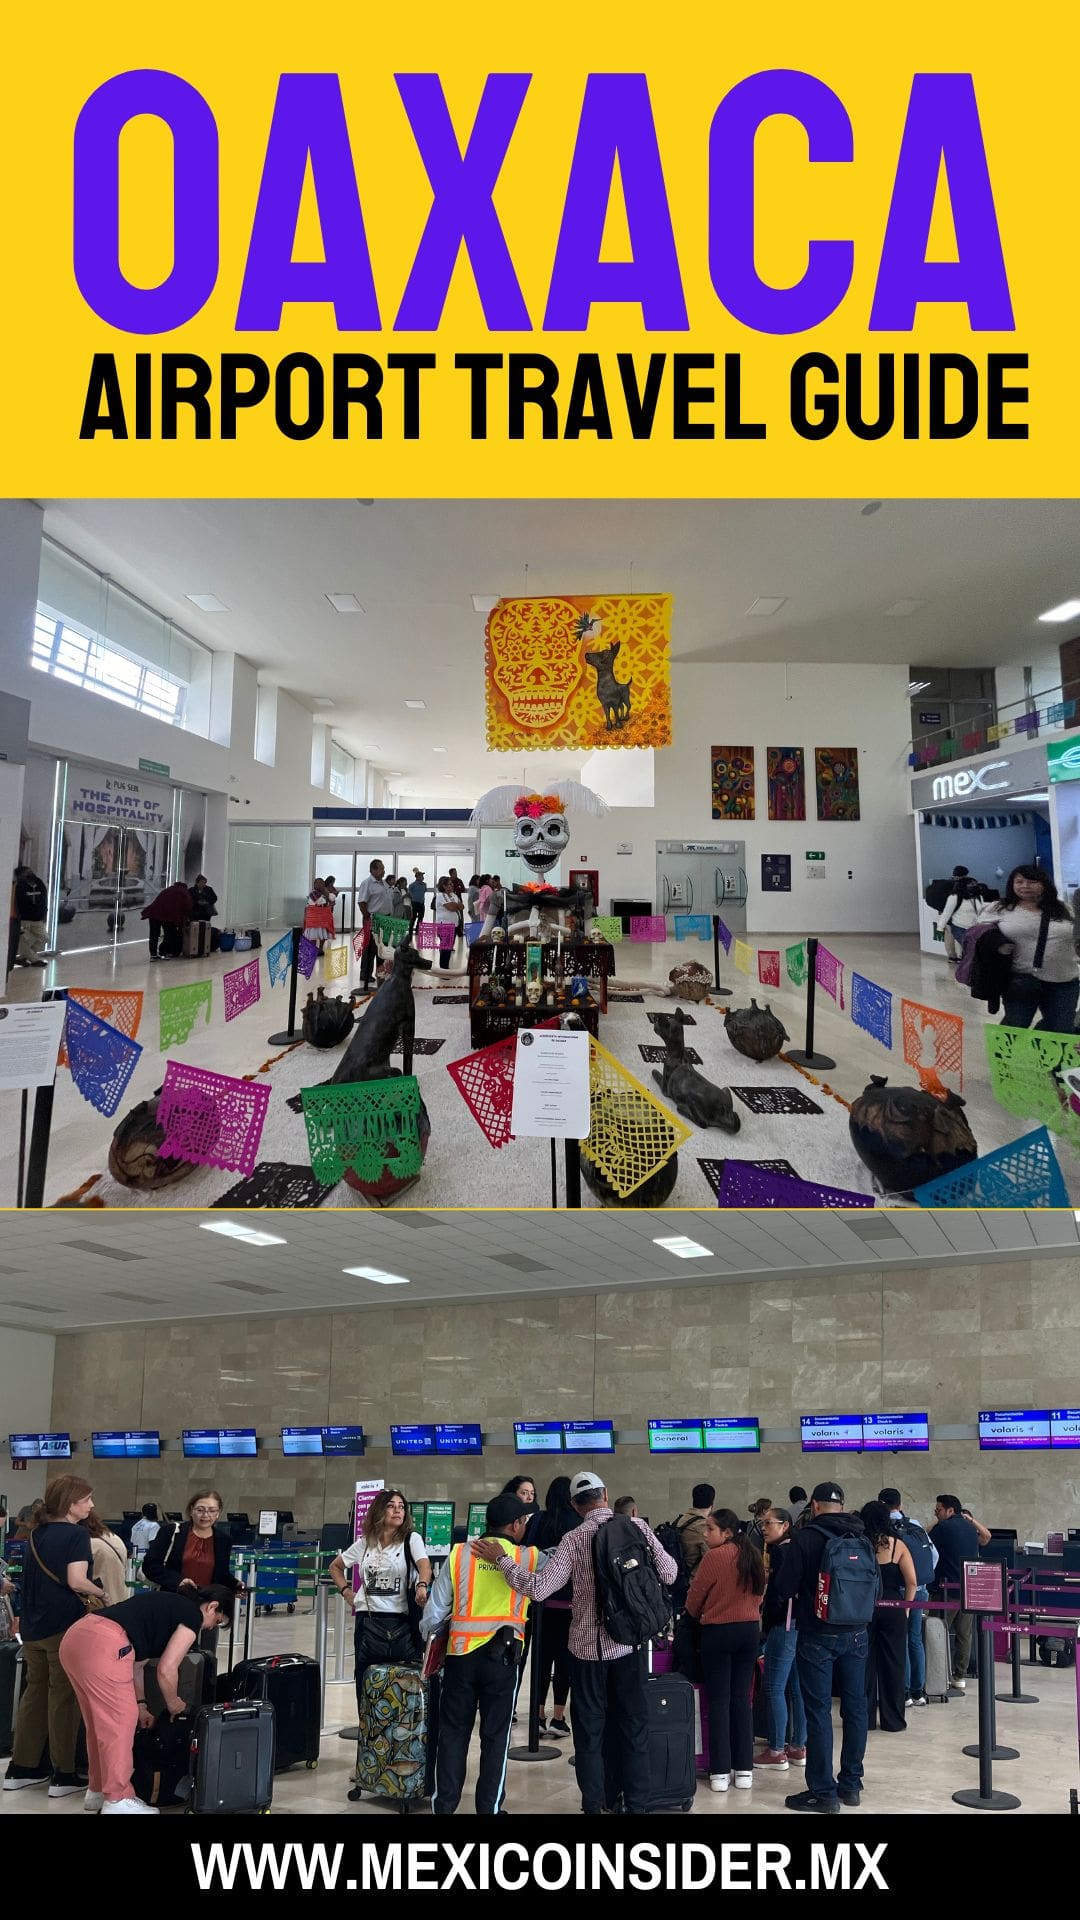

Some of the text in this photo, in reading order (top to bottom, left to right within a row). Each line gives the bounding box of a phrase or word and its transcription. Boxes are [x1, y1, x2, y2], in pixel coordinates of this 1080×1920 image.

[80, 788, 160, 811] THE ART OF
[72, 800, 164, 823] HOSPITALITY
[864, 1416, 873, 1424] 13
[980, 1413, 990, 1421] 12
[1052, 1411, 1061, 1420] 11
[873, 1428, 904, 1436] volaris
[41, 1441, 69, 1451] ASUR
